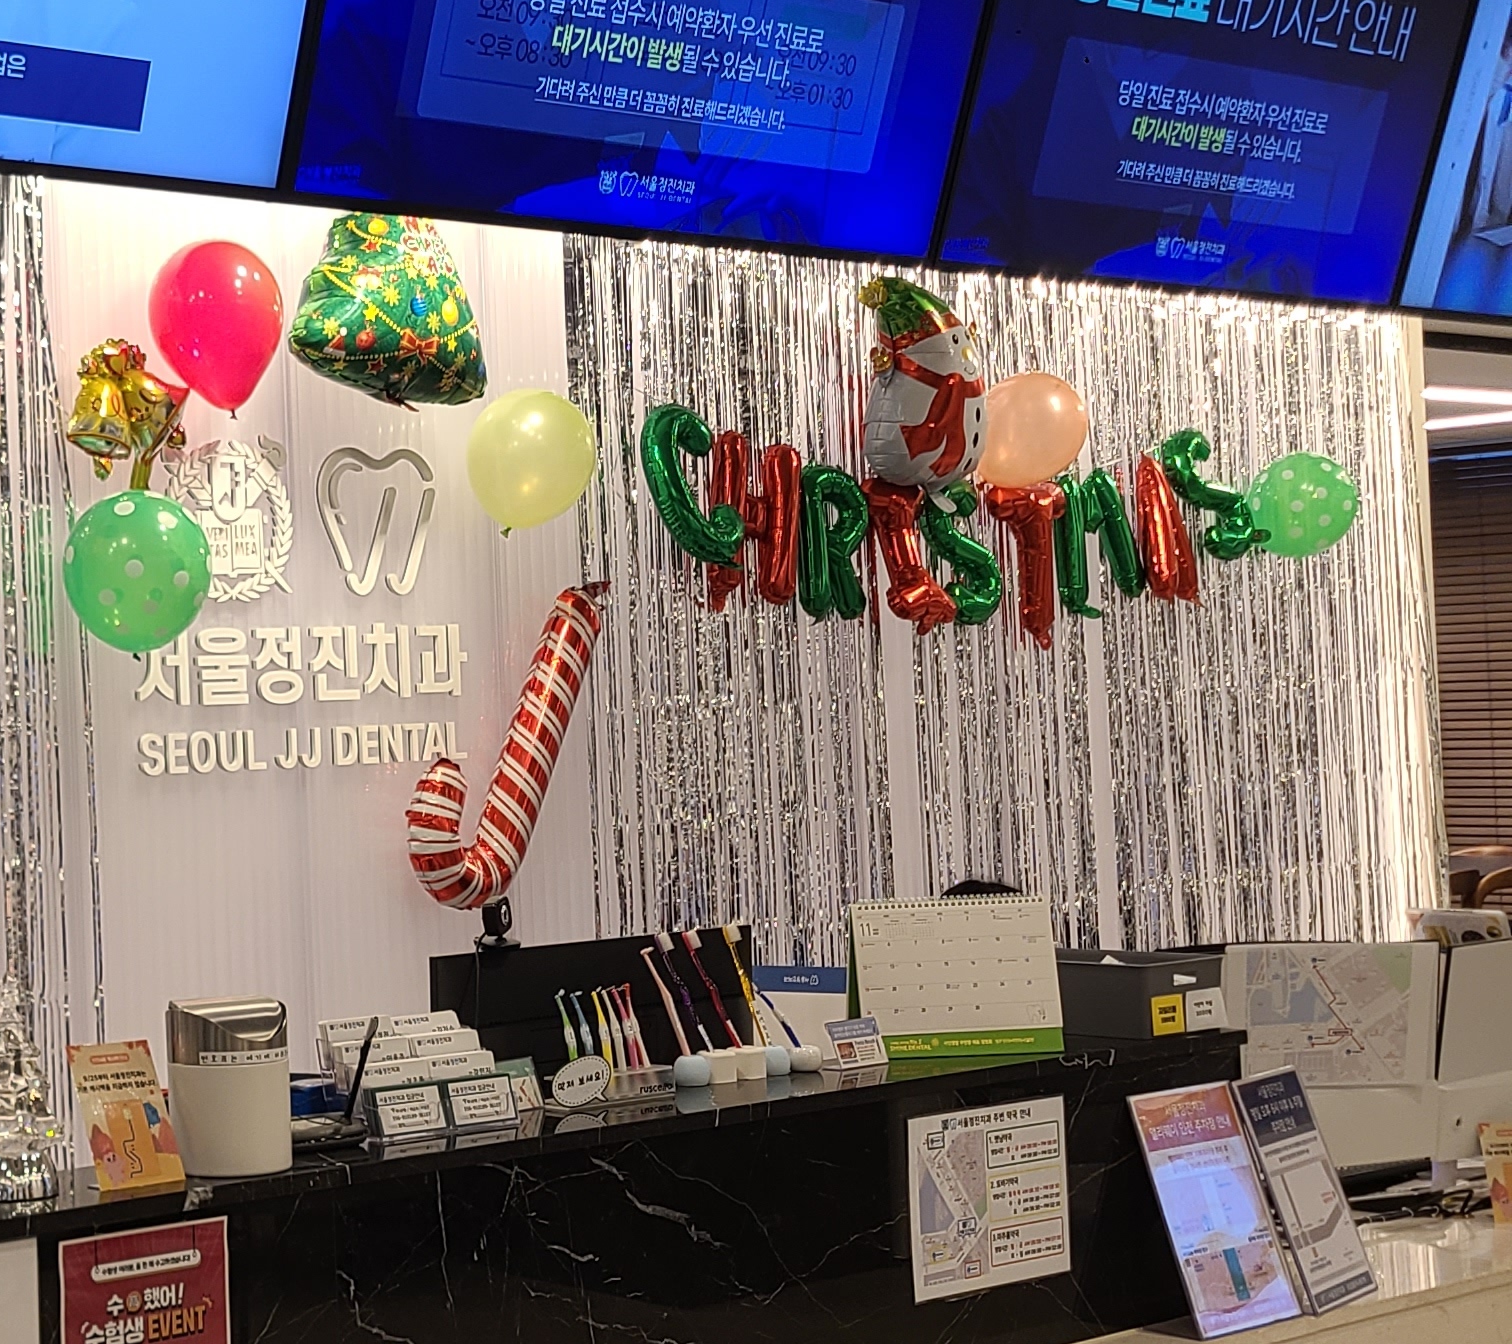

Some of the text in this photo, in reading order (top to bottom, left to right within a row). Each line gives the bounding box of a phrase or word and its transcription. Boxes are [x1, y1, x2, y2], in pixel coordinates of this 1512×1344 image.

[667, 4, 737, 43] 예약환자
[737, 16, 774, 51] 우선
[775, 20, 825, 55] 진료로
[552, 24, 791, 88] 대기시간이 발생될 수 있습니다.
[536, 75, 786, 130] 기다려 주신 만큼 더 꼼꼼히 진료해드리겠습니다.
[1118, 80, 1329, 135] 당일 진료 접수시 예약환자 우선 진료로
[1131, 115, 1302, 164] 대기시간이 발생될 수 있습니다.
[1116, 159, 1145, 180] 기다려
[1145, 164, 1165, 183] 주신
[1165, 167, 1183, 185] 만큼
[1183, 169, 1192, 186] 더
[1192, 171, 1219, 190] 꼼꼼히
[234, 524, 256, 539] LUX
[234, 541, 258, 557] MEA
[641, 403, 1271, 651] CHRISTMAS
[135, 622, 468, 707] 서울정진치과
[138, 721, 468, 777] SEOUL JJ DENTAL
[958, 1115, 991, 1128] 서울정진치과
[148, 1305, 206, 1340] EVENT
